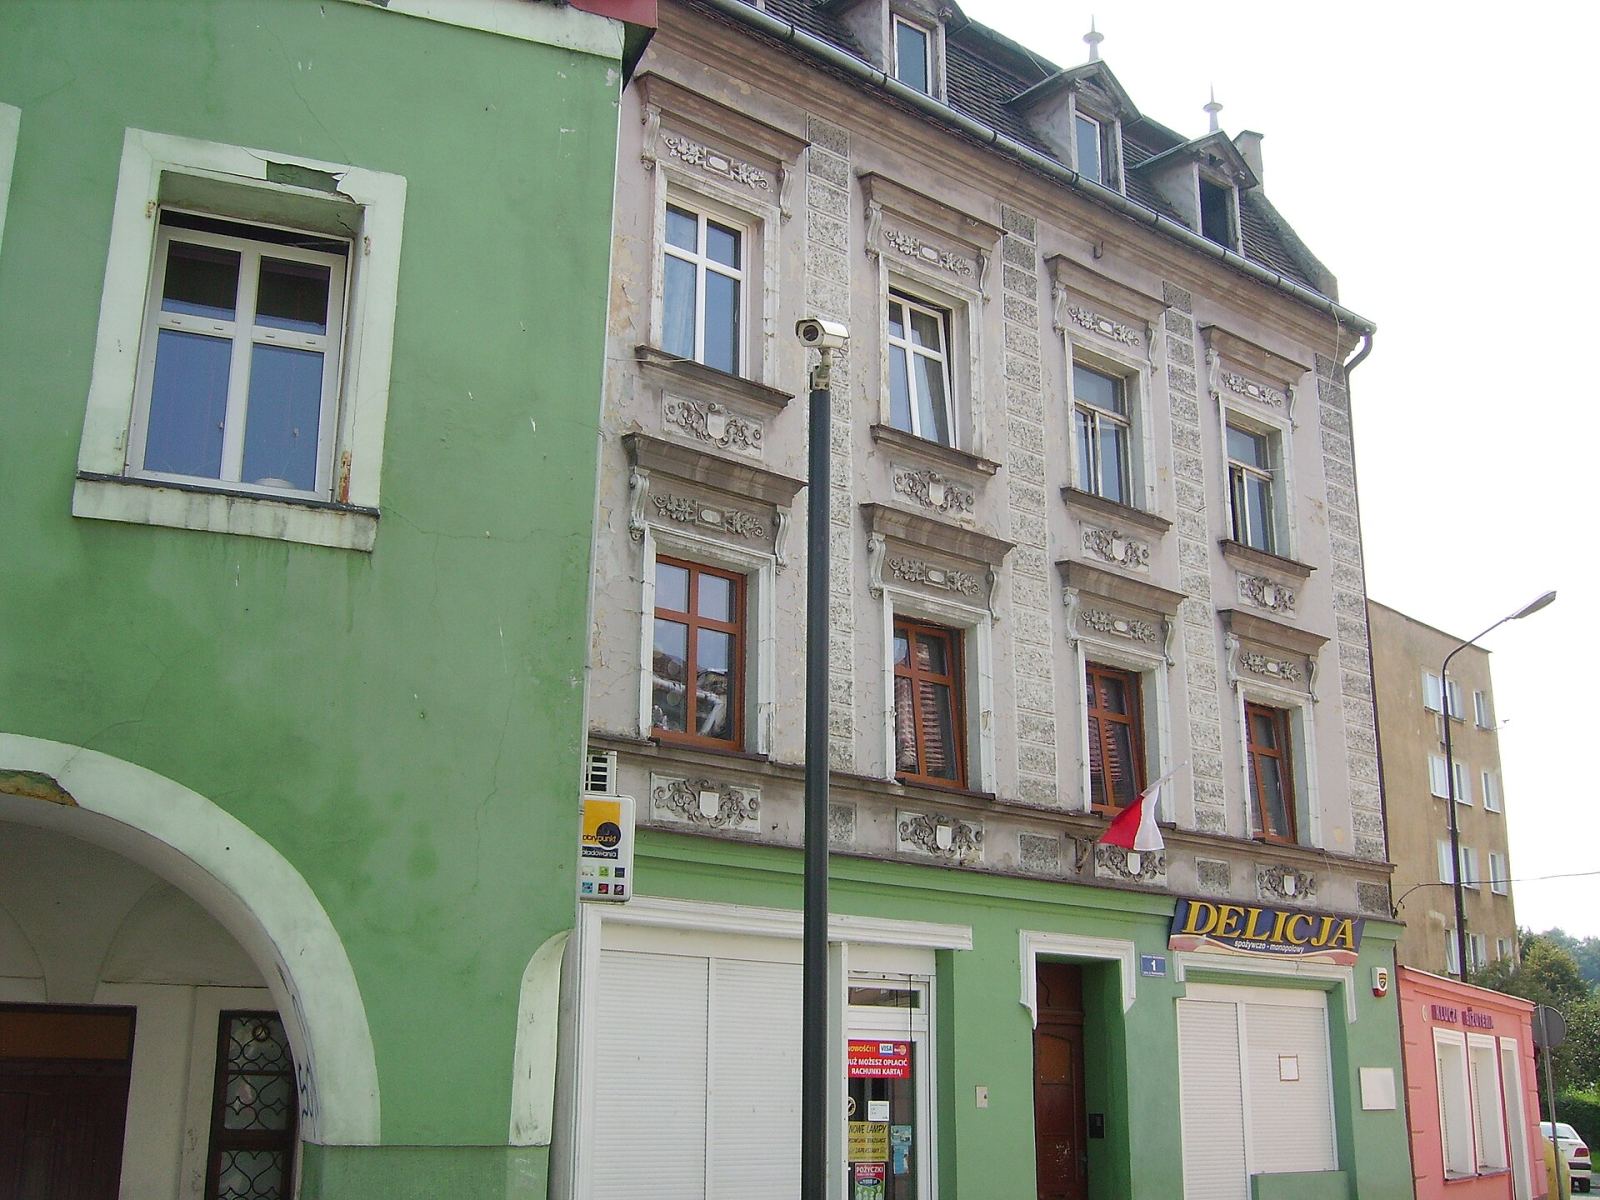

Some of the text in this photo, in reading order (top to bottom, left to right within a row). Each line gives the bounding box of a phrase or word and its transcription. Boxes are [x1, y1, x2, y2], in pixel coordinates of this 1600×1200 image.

[1181, 900, 1355, 949] DELICJA
[1234, 940, 1266, 950] spożywczo
[1270, 944, 1304, 953] monopolowy
[1151, 959, 1156, 971] 1
[858, 1057, 882, 1066] MOŻESZ
[852, 1067, 881, 1075] RACHUNKI
